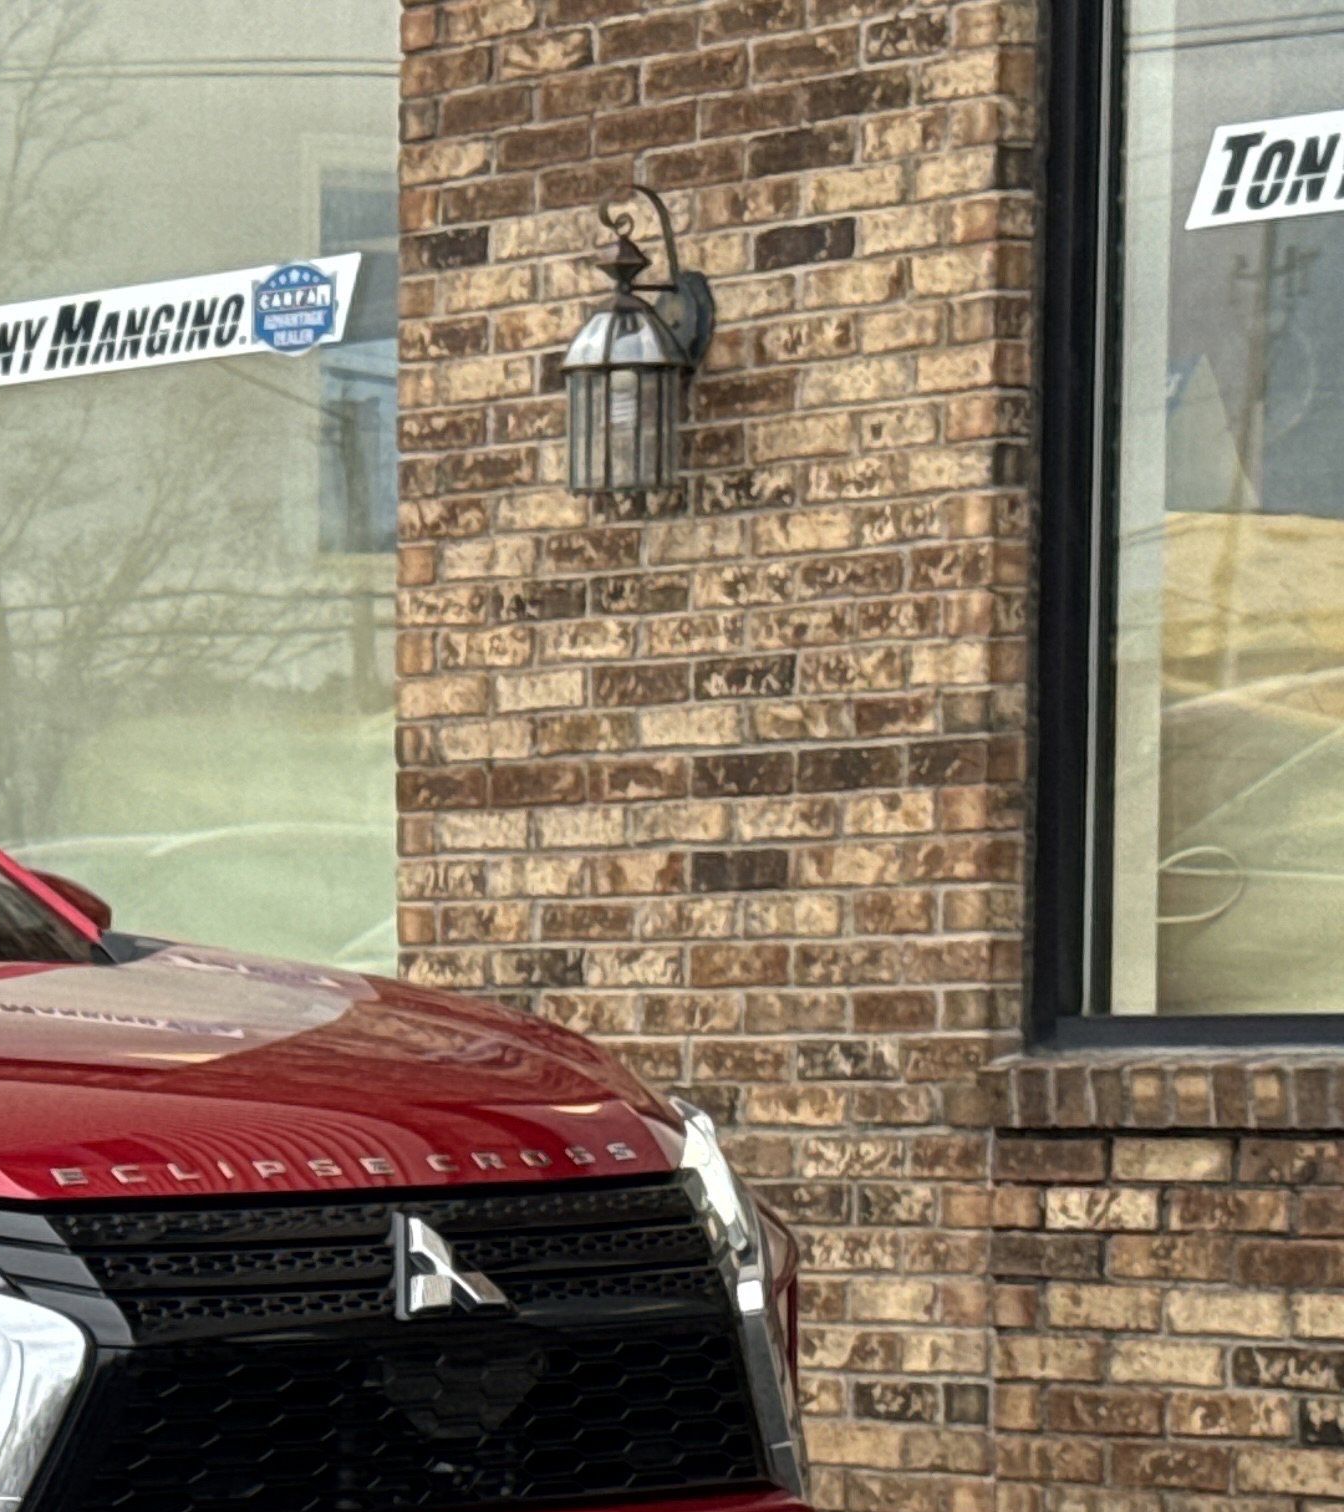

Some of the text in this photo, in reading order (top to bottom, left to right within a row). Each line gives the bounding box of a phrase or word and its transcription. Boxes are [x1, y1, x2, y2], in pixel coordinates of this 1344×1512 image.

[1211, 130, 1344, 216] TON
[50, 1141, 638, 1187] ECLIPSE CROSS
